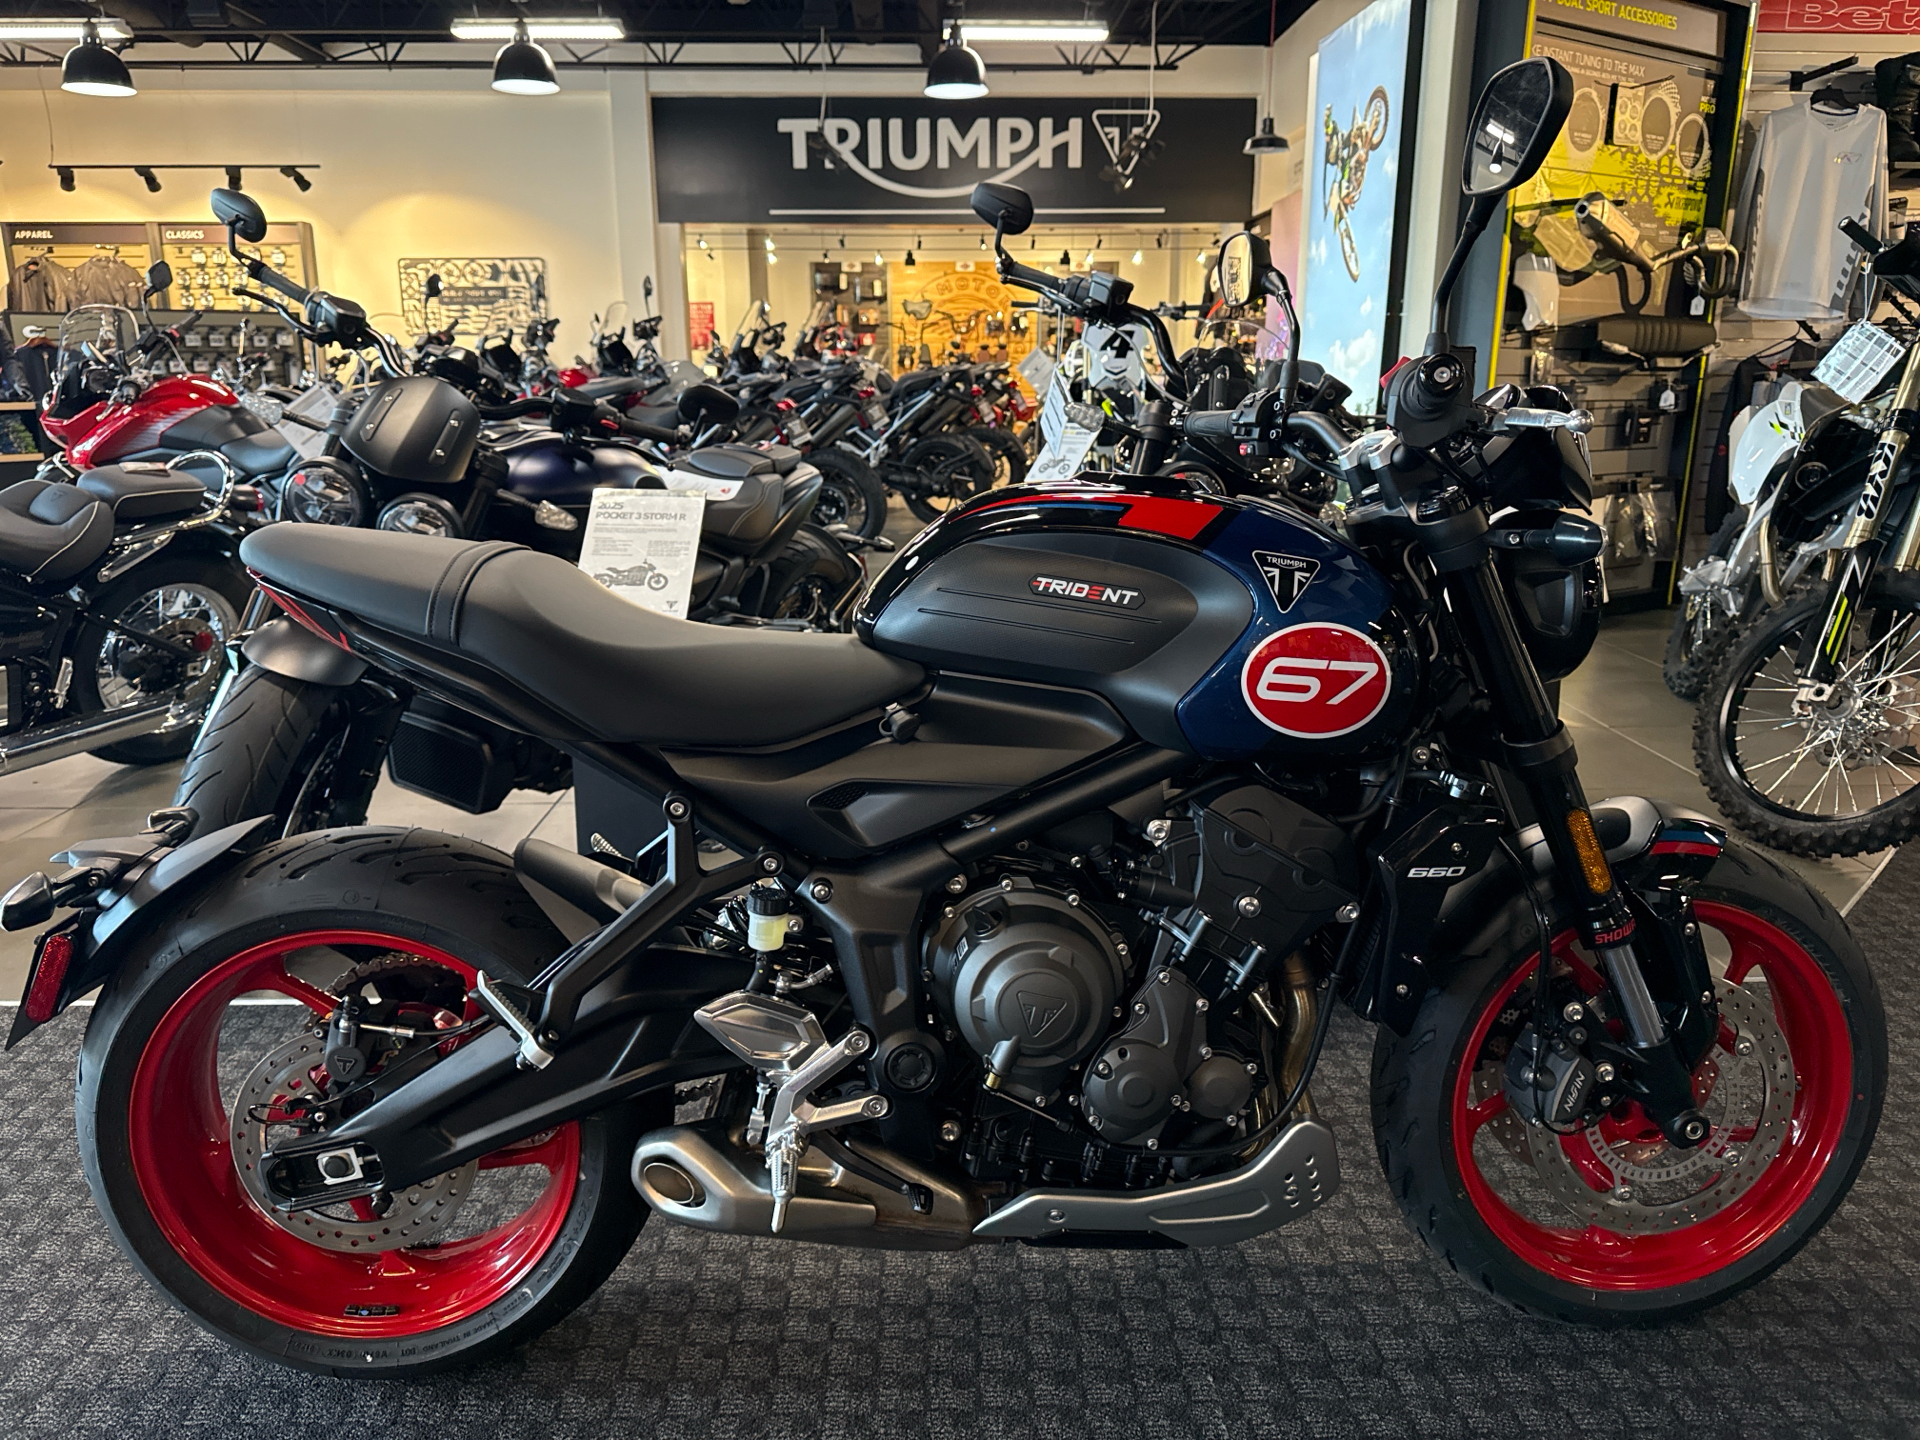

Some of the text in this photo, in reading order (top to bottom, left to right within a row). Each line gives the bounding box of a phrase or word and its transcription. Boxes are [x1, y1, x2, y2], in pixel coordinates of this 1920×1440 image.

[1586, 0, 1617, 17] SPORT
[1618, 7, 1678, 31] ACCESSORIES
[1785, 0, 1920, 31] Bet
[1543, 45, 1574, 62] INSTANT
[1603, 56, 1613, 71] TO
[1614, 58, 1628, 74] THE
[1628, 63, 1646, 78] MAX
[1700, 102, 1717, 115] PRO
[777, 117, 1083, 198] TRIUMPH
[15, 230, 53, 239] APPAREL
[166, 230, 204, 240] CLASSICS
[1100, 330, 1135, 358] 4
[597, 501, 625, 510] 2025
[635, 511, 642, 520] 3
[643, 511, 678, 521] STORM
[678, 512, 687, 521] R
[1266, 555, 1307, 570] TRIUMPH
[1032, 576, 1139, 605] TRIDENT
[1256, 656, 1379, 706] 67
[1407, 866, 1467, 878] 660
[422, 1334, 461, 1352] THAILAND
